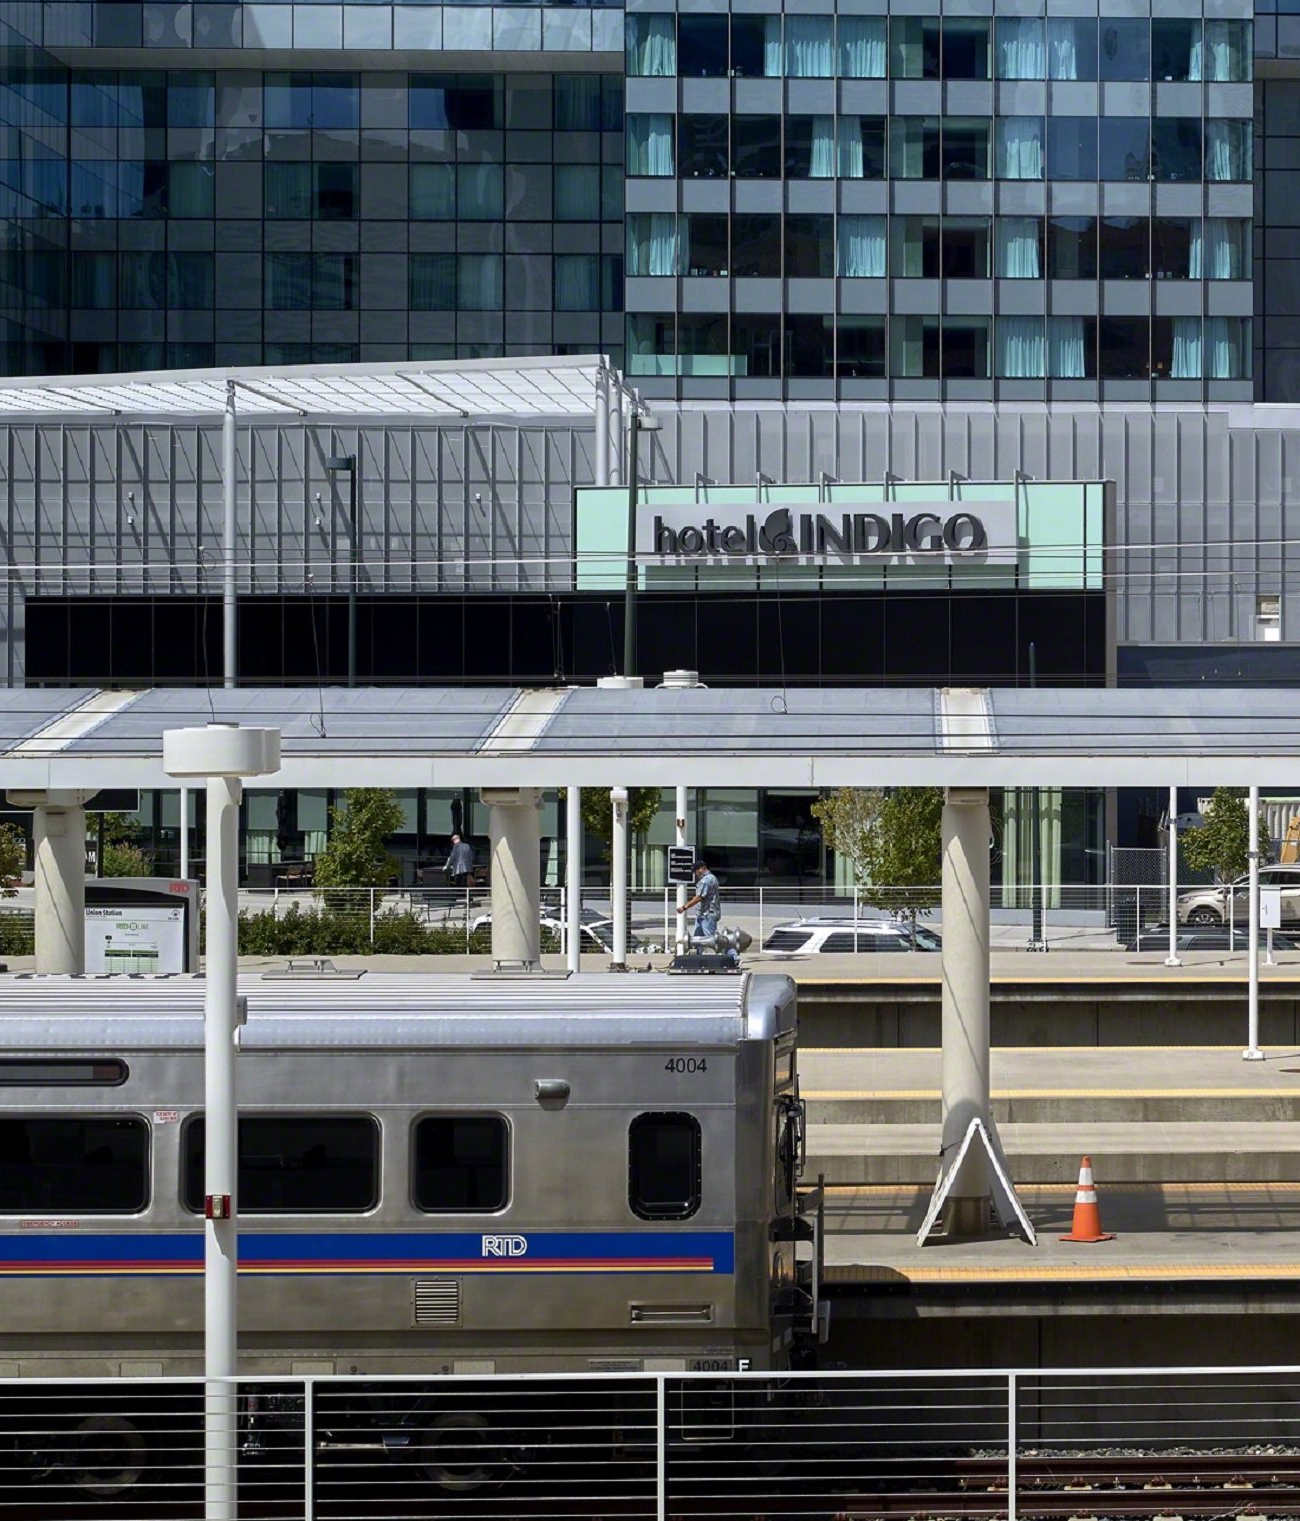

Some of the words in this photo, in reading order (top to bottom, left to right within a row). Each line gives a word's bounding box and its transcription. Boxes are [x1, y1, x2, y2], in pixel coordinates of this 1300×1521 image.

[653, 513, 756, 553] hotel
[799, 512, 986, 553] INDIGO
[664, 1058, 708, 1073] 4004
[482, 1235, 528, 1257] RTD
